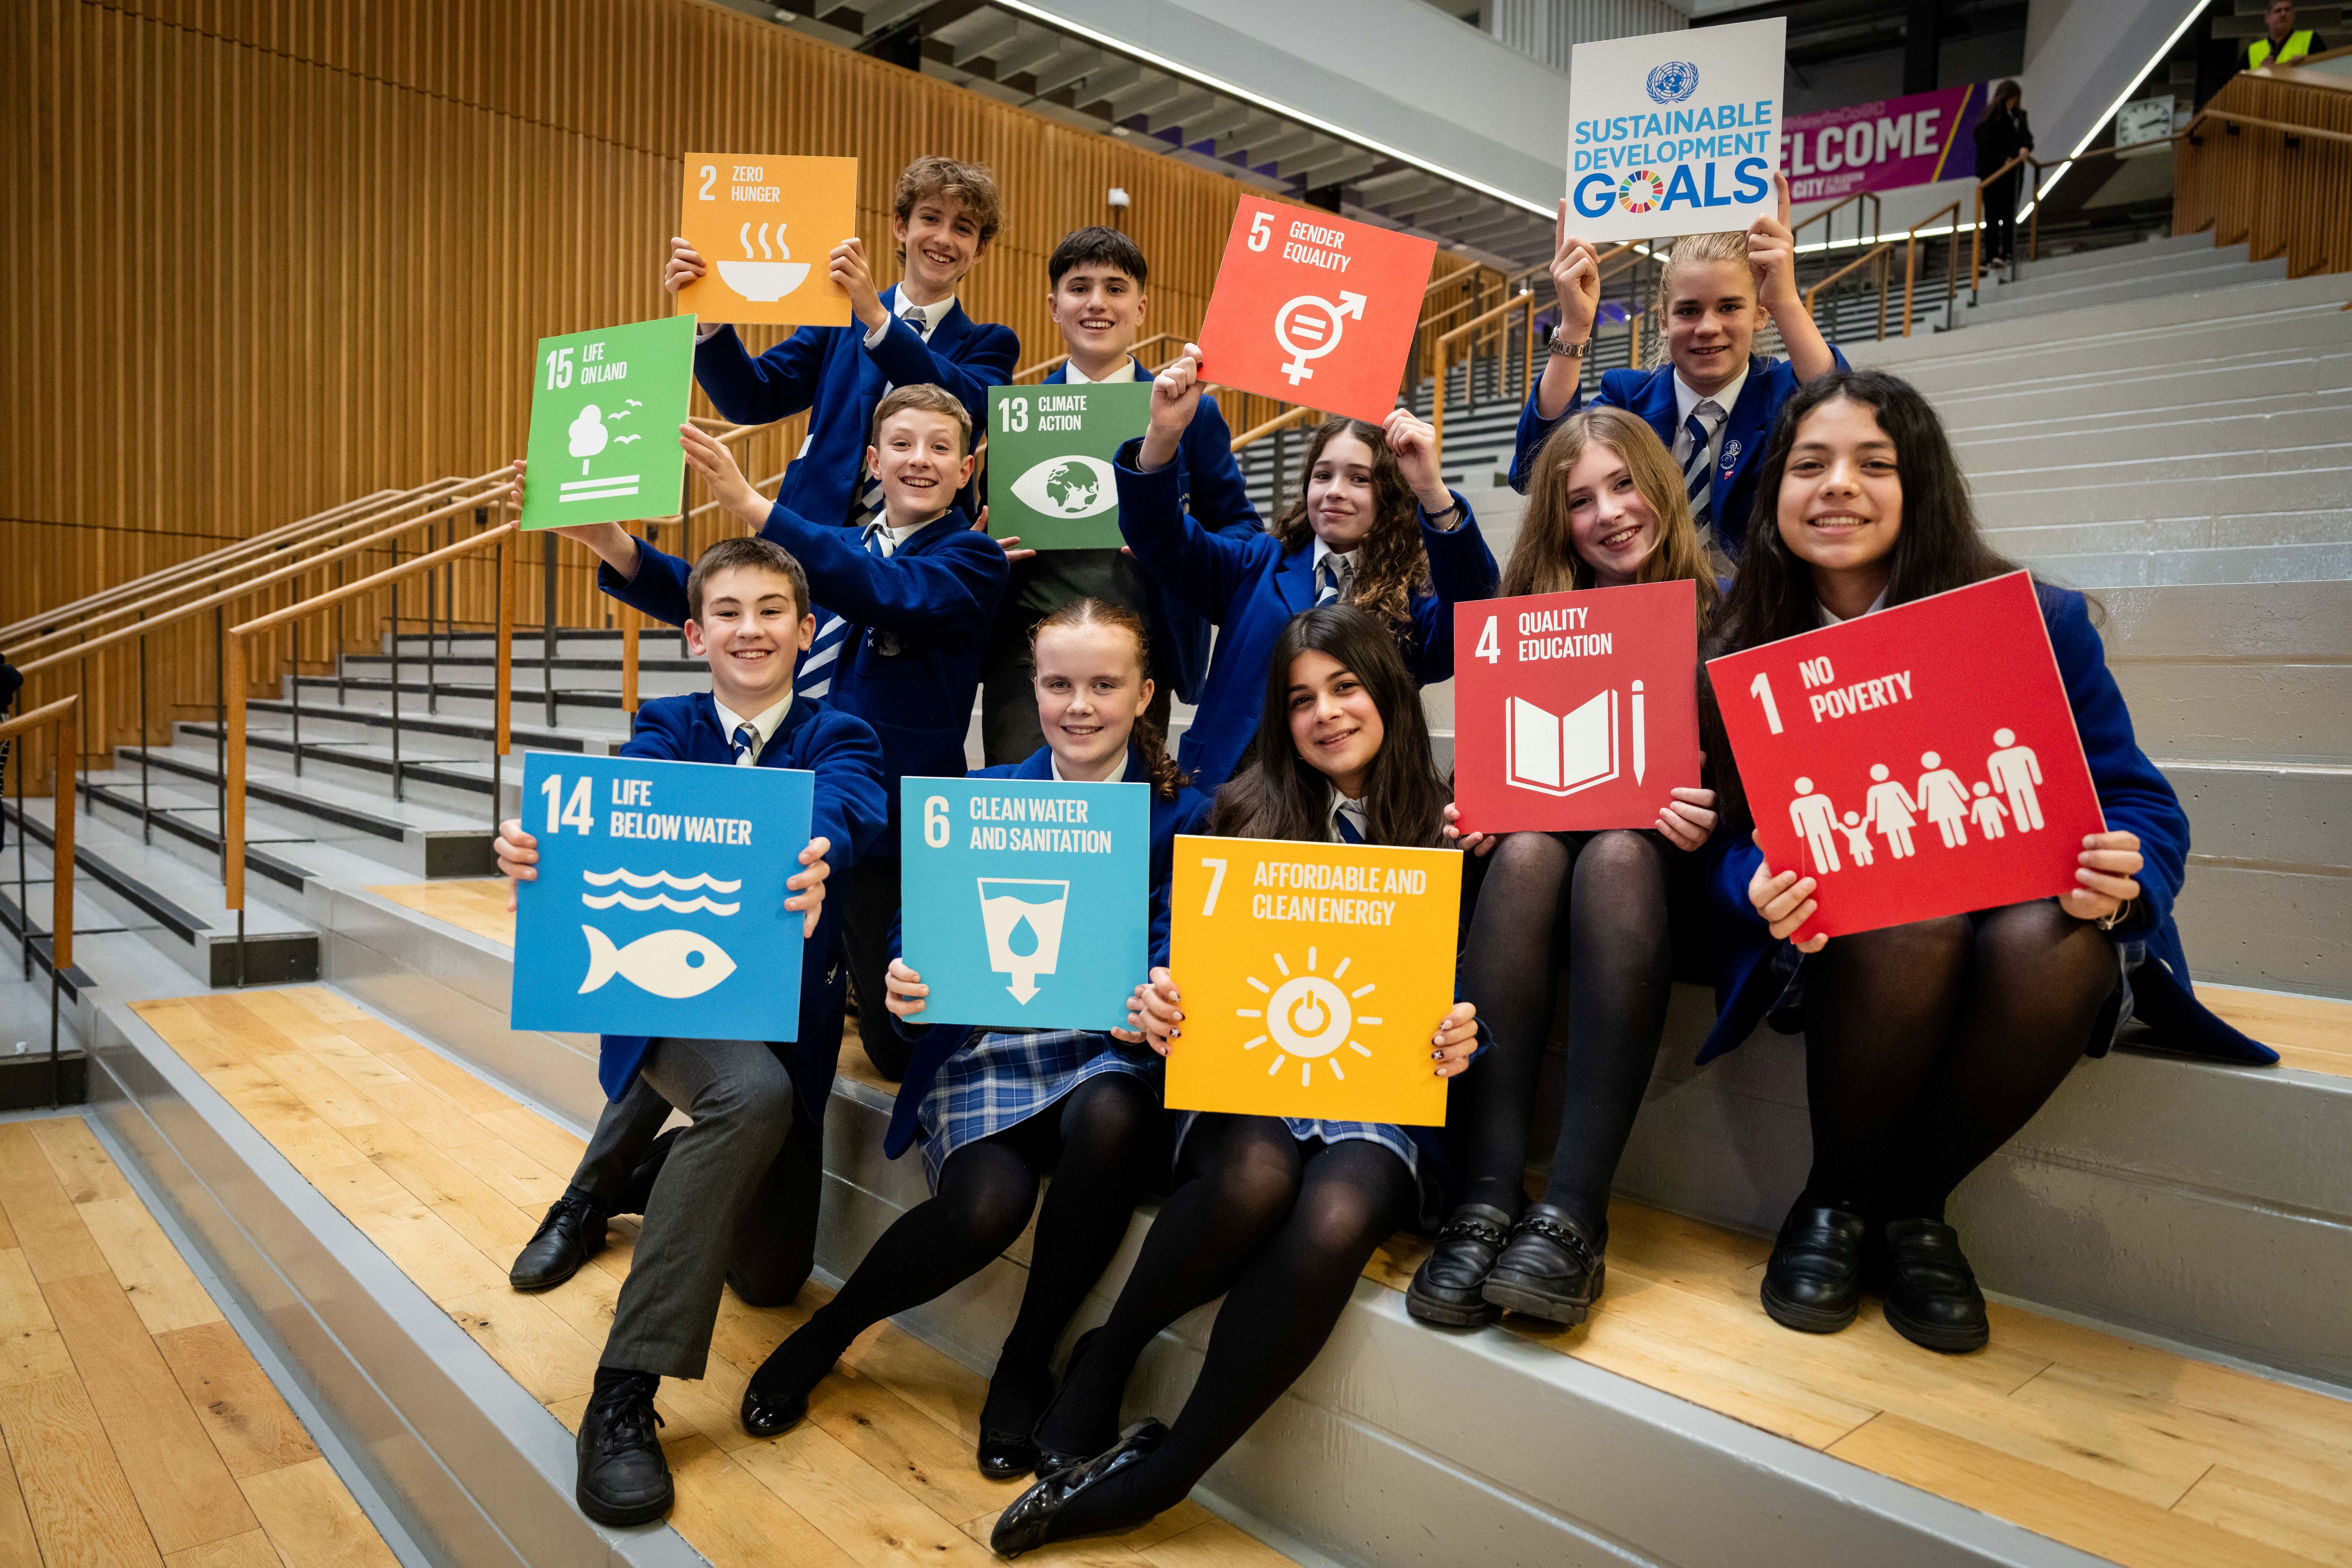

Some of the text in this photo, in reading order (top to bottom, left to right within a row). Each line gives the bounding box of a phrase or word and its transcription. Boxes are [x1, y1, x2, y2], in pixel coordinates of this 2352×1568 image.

[1575, 100, 1772, 144] SUSTAINABLE
[1575, 131, 1771, 171] DEVELOPMENT
[699, 165, 716, 201] 2
[732, 166, 763, 182] ZERO
[1574, 158, 1768, 218] GOALS
[1792, 177, 1825, 199] CITY
[732, 186, 780, 202] HUNGER
[1248, 211, 1275, 252] 5
[1290, 221, 1345, 249] GENDER
[1283, 242, 1351, 272] EQUALITY
[583, 343, 605, 362] LIFE
[546, 348, 574, 390] 15
[581, 362, 627, 385] ON LAND
[999, 397, 1028, 432] 13
[1038, 396, 1087, 411] CLIMATE
[1038, 415, 1081, 431] ACTION
[1519, 607, 1588, 635] QUALITY
[1475, 615, 1501, 663] 4
[1519, 633, 1612, 661] EDUCATION
[1799, 656, 1834, 688] NO
[1750, 672, 1783, 735] 1
[1810, 670, 1913, 723] POVERTY
[541, 774, 594, 835] 14
[612, 779, 653, 807] LIFE
[924, 796, 950, 848] 6
[970, 797, 1088, 822] CLEAN WATER
[610, 811, 752, 845] BELOW WATER
[970, 827, 1111, 853] AND SANITATION
[1201, 858, 1227, 916] 7
[1253, 861, 1426, 894] AFFORDABLE AND
[1253, 894, 1395, 926] CLEAN ENERGY
